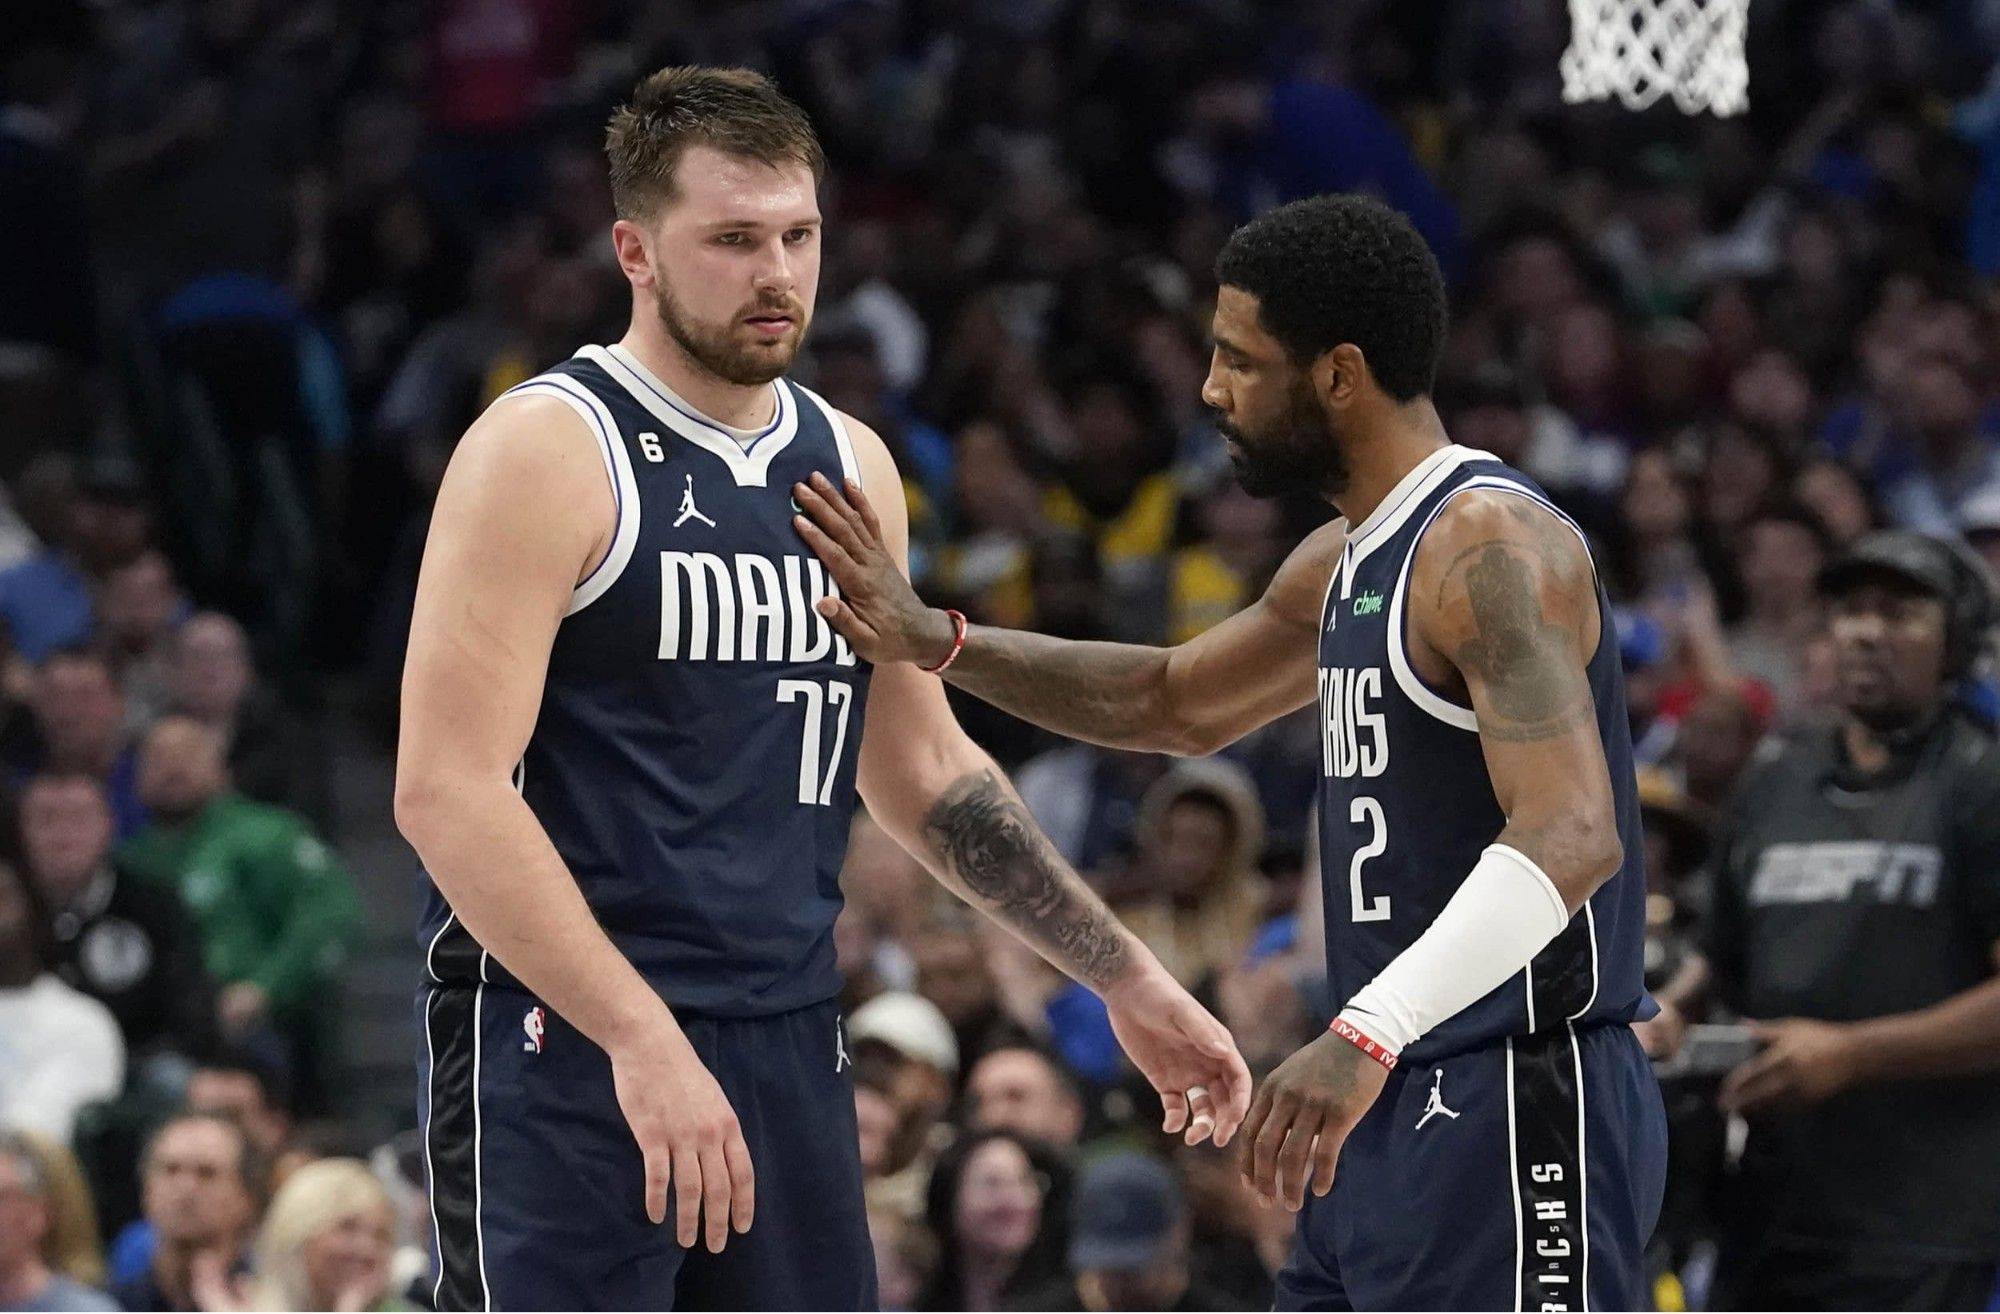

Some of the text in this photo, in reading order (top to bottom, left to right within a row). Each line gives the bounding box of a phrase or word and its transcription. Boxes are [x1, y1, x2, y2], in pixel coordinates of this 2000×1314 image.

[638, 432, 665, 462] 6
[776, 679, 852, 806] 77
[1349, 796, 1391, 923] 2
